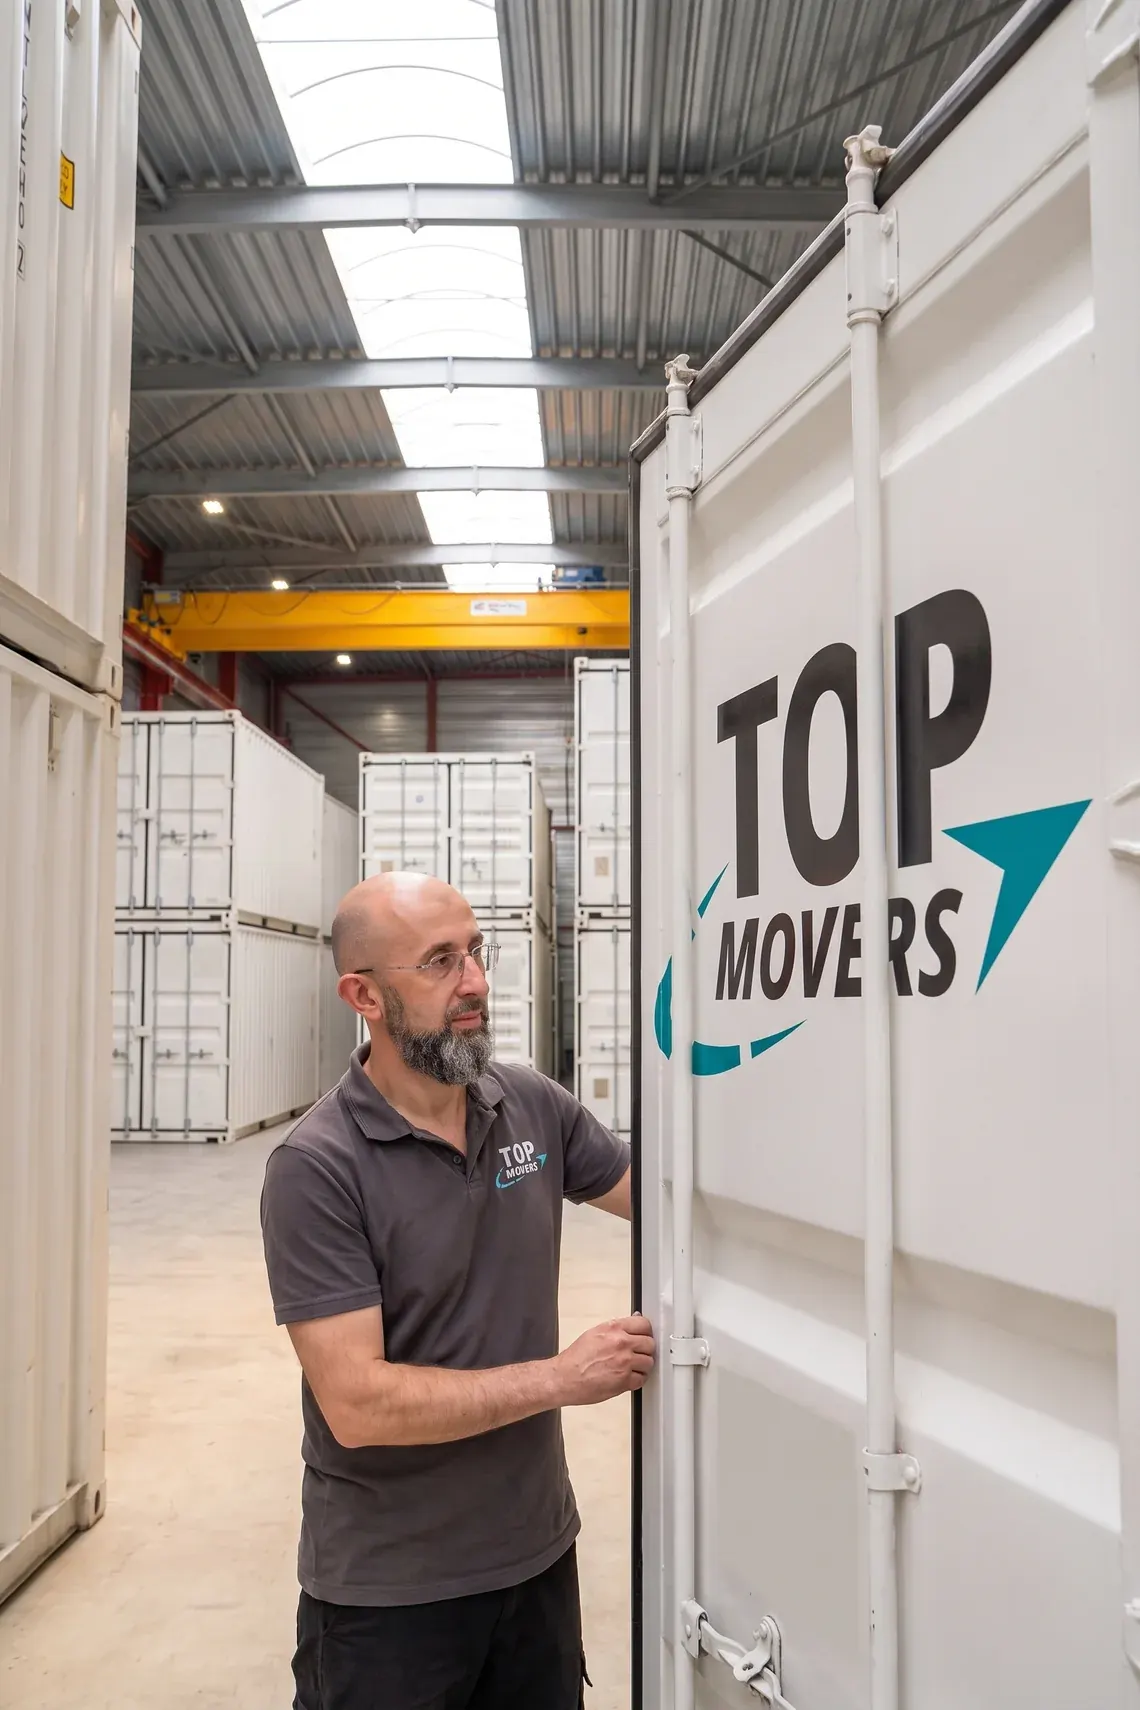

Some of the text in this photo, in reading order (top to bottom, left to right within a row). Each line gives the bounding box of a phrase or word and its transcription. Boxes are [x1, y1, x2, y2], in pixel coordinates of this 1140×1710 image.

[717, 588, 992, 899] TOP
[498, 1140, 535, 1168] TOP
[505, 1161, 539, 1179] MOVERS
